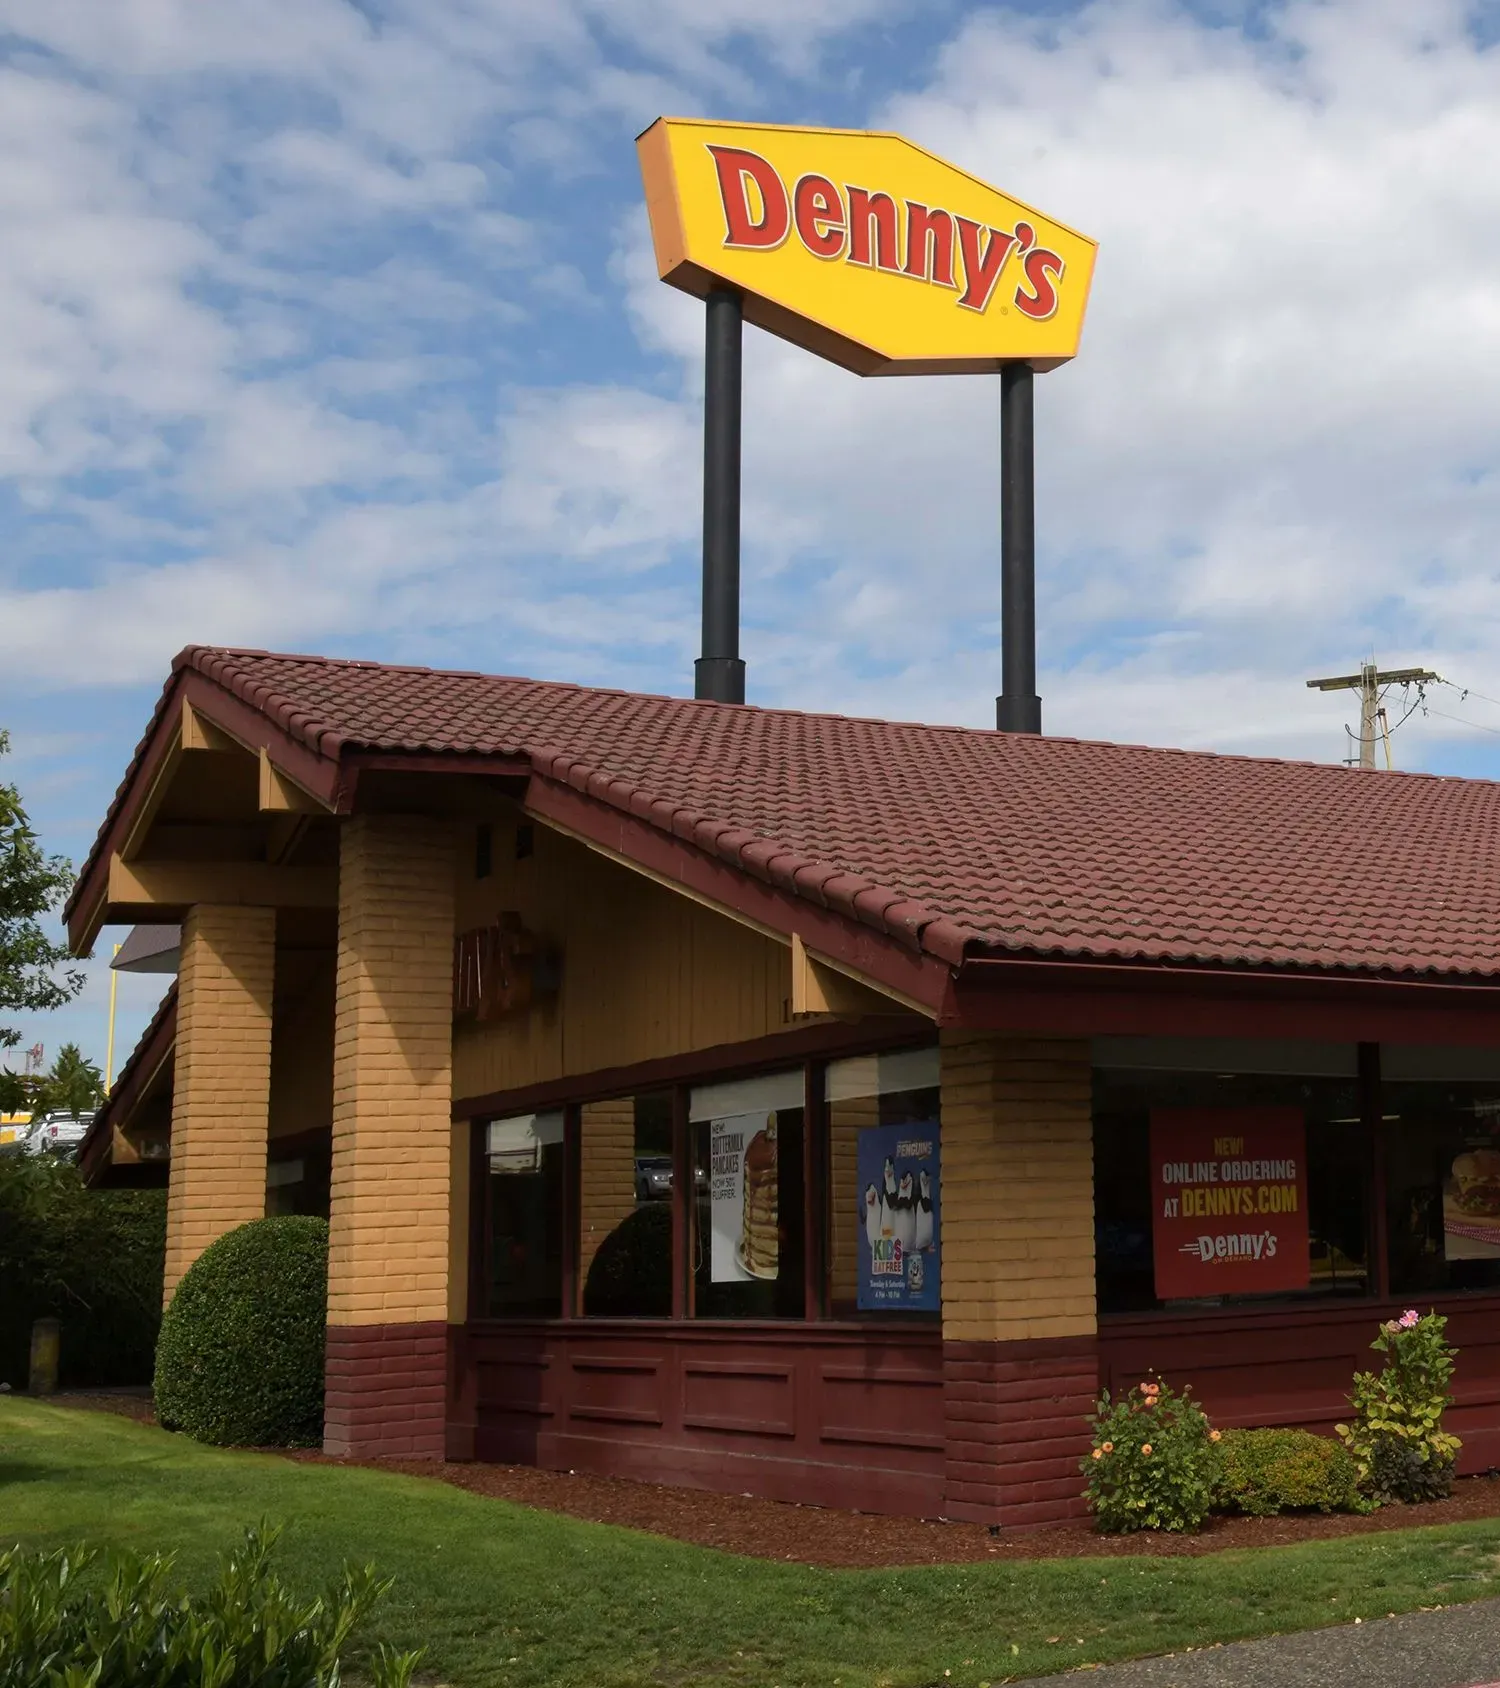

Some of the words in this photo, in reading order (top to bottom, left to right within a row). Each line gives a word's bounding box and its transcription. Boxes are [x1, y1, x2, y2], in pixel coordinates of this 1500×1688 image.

[704, 144, 1066, 320] Denny's
[1213, 1136, 1244, 1157] NEW!
[1162, 1161, 1219, 1184] ONLINE
[1221, 1159, 1296, 1182] ORDERING
[1163, 1198, 1179, 1218] AT
[1180, 1184, 1299, 1218] DENNYS.COM
[873, 1238, 903, 1261] KIDS
[1196, 1230, 1278, 1262] Denny's
[886, 1261, 903, 1273] FREE
